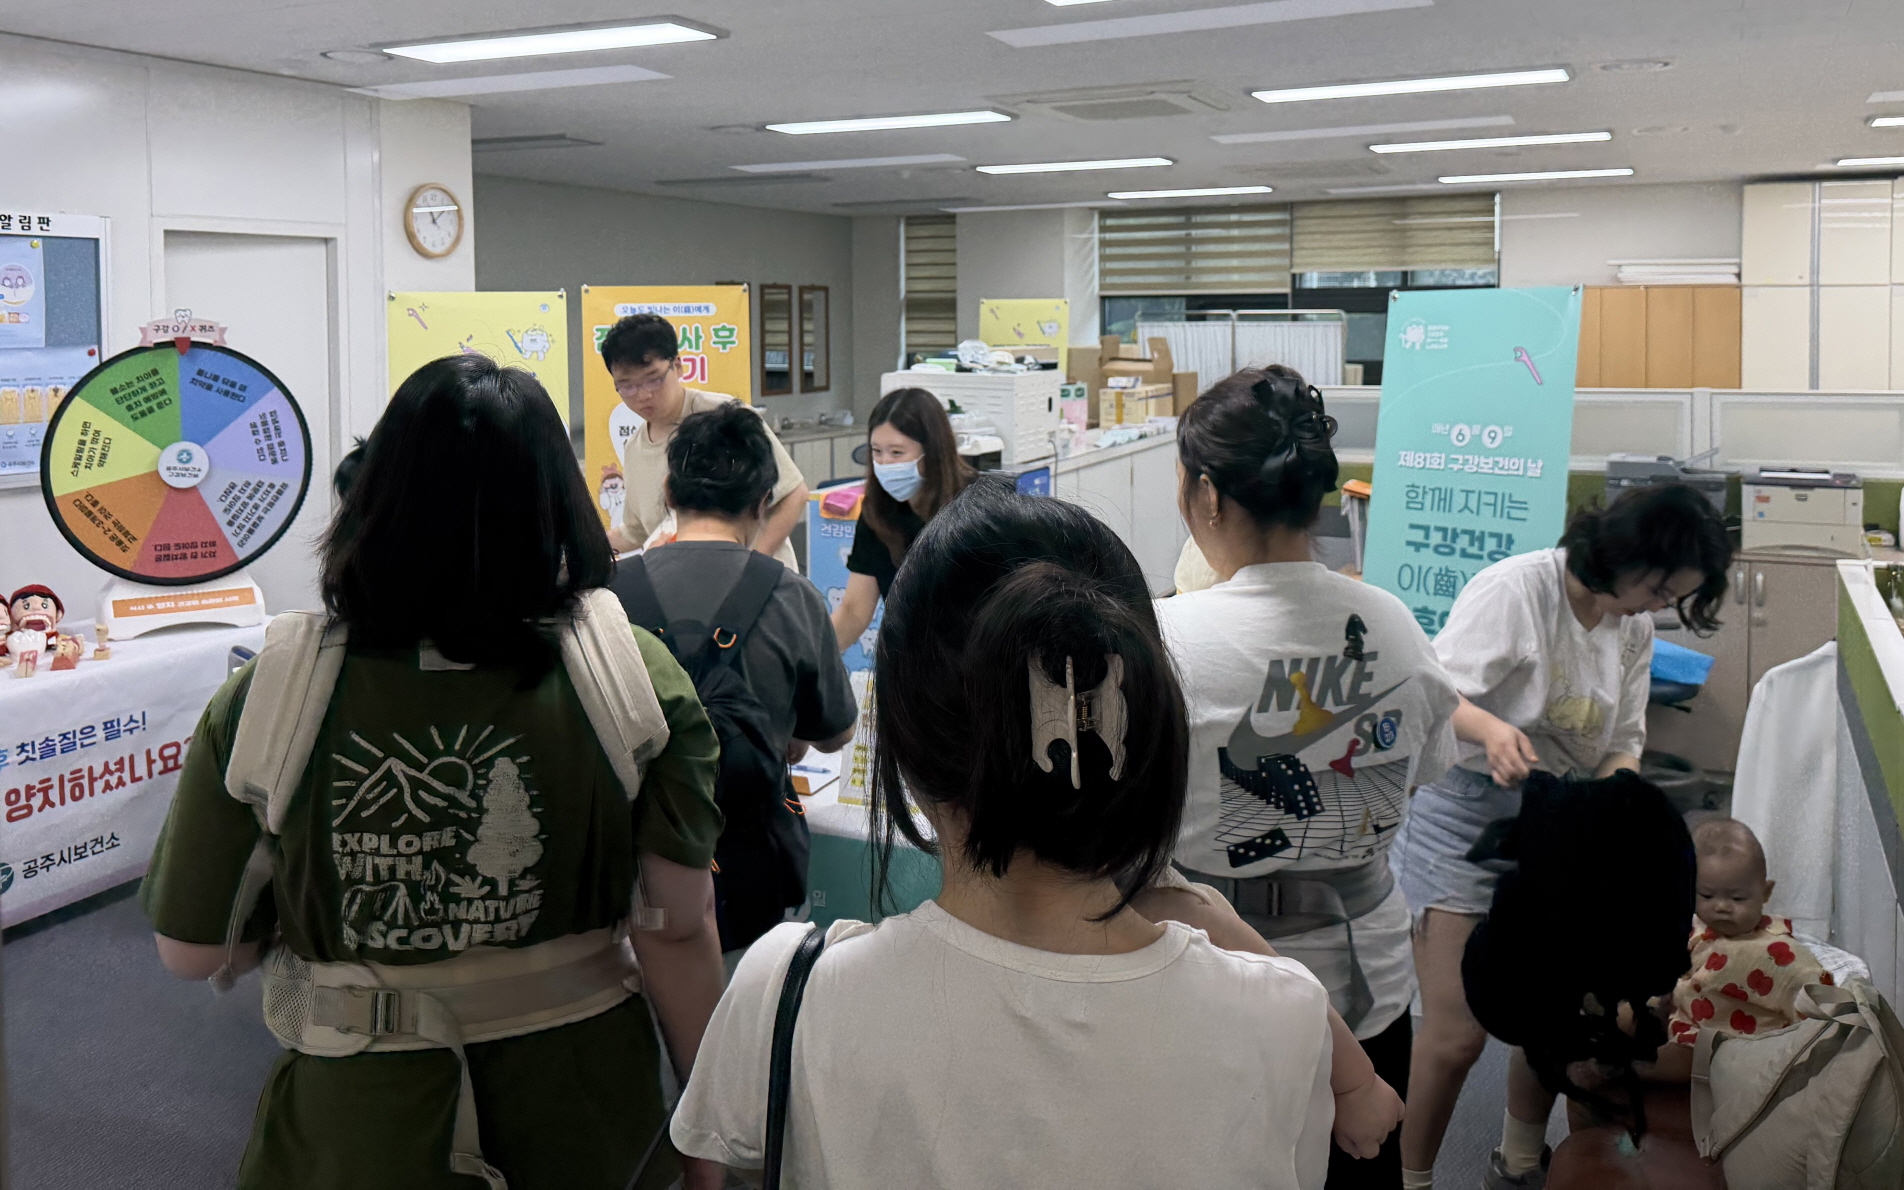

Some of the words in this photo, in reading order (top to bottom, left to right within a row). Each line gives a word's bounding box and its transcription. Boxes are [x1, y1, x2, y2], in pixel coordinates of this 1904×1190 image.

[622, 305, 645, 314] 오늘도
[153, 324, 170, 334] 구강
[198, 324, 216, 333] 퀴즈
[711, 324, 737, 351] 후
[114, 386, 149, 405] 단단하게
[148, 377, 166, 390] 하고
[142, 387, 168, 404] 예방에
[215, 387, 247, 403] 사용한다
[130, 405, 156, 422] 도움을
[156, 397, 173, 411] 준다
[70, 438, 87, 478] 스케일링을
[80, 420, 92, 437] 하면
[84, 445, 98, 471] 치아가
[96, 436, 113, 468] 약해진다
[256, 446, 267, 462] 있다
[1397, 450, 1446, 471] 제81회
[1448, 453, 1525, 476] 구강보건의
[1526, 458, 1544, 478] 날
[237, 480, 252, 495] 하지
[97, 505, 114, 521] 것이
[1404, 483, 1454, 514] 함께
[1457, 489, 1530, 523] 지키는
[108, 532, 131, 553] 칫솔은
[111, 518, 138, 544] 교체하는
[1404, 523, 1515, 563] 구강건강
[154, 552, 188, 563] 양치질은
[173, 540, 199, 551] 않아도
[190, 551, 198, 560] 전
[200, 540, 217, 549] 하지
[200, 549, 217, 559] 자기
[1397, 562, 1479, 600] 이(齒)
[1257, 651, 1379, 713] NIKE
[16, 724, 97, 766] 칫솔질은
[102, 711, 147, 742] 필수!
[331, 826, 457, 855] EXPLORE
[22, 832, 121, 880] 공주시보건소
[333, 853, 424, 881] WITH
[448, 889, 545, 921] NATURE
